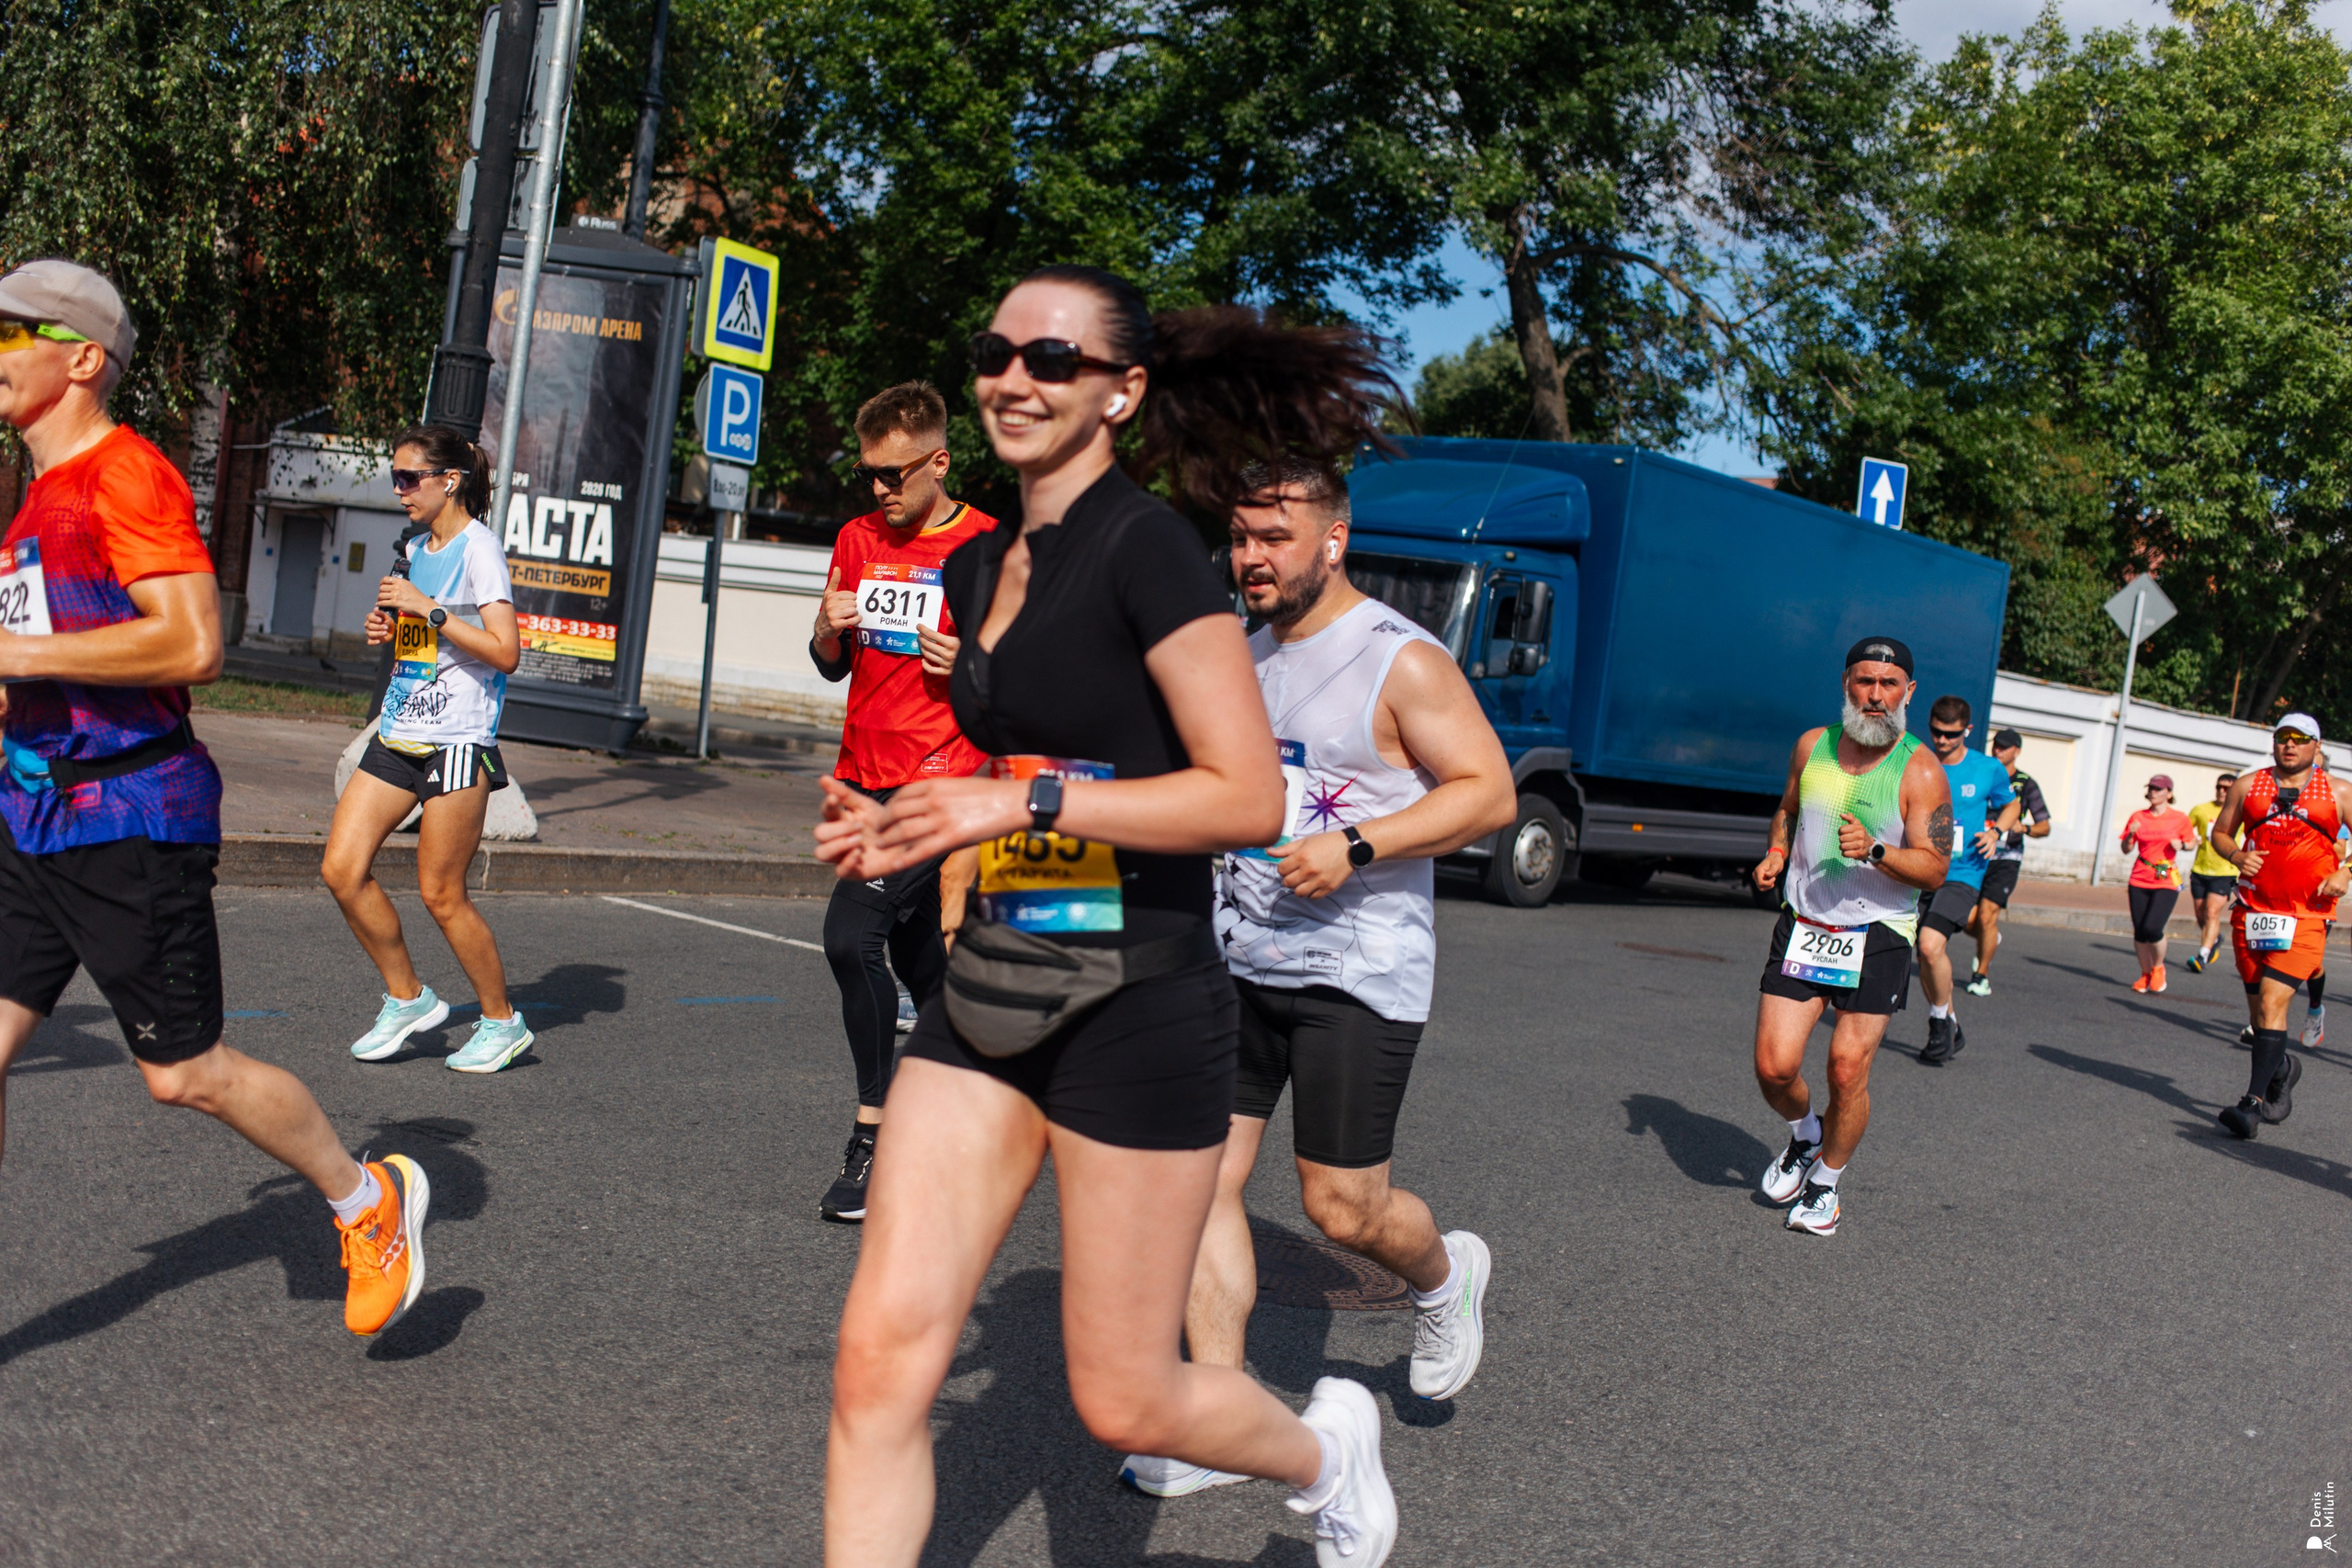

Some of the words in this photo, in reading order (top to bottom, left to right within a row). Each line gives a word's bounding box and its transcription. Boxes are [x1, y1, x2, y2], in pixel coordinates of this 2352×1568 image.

[532, 310, 597, 335] АЗПРОМ
[599, 318, 642, 341] АРЕНА
[720, 378, 752, 446] P
[605, 483, 623, 501] ГОД
[503, 492, 614, 566] АСТА
[507, 565, 607, 590] Т-ПЕТЕРБУРГ
[865, 587, 927, 618] 6311
[527, 615, 616, 640] 363-33-33
[879, 616, 909, 626] РОМАН
[1961, 784, 1976, 797] 10
[2265, 828, 2305, 840] running
[2270, 838, 2297, 846] team
[2252, 917, 2287, 931] 6051
[1801, 931, 1854, 957] 2906
[1812, 954, 1838, 964] РУСЛАН
[1789, 964, 1801, 976] D
